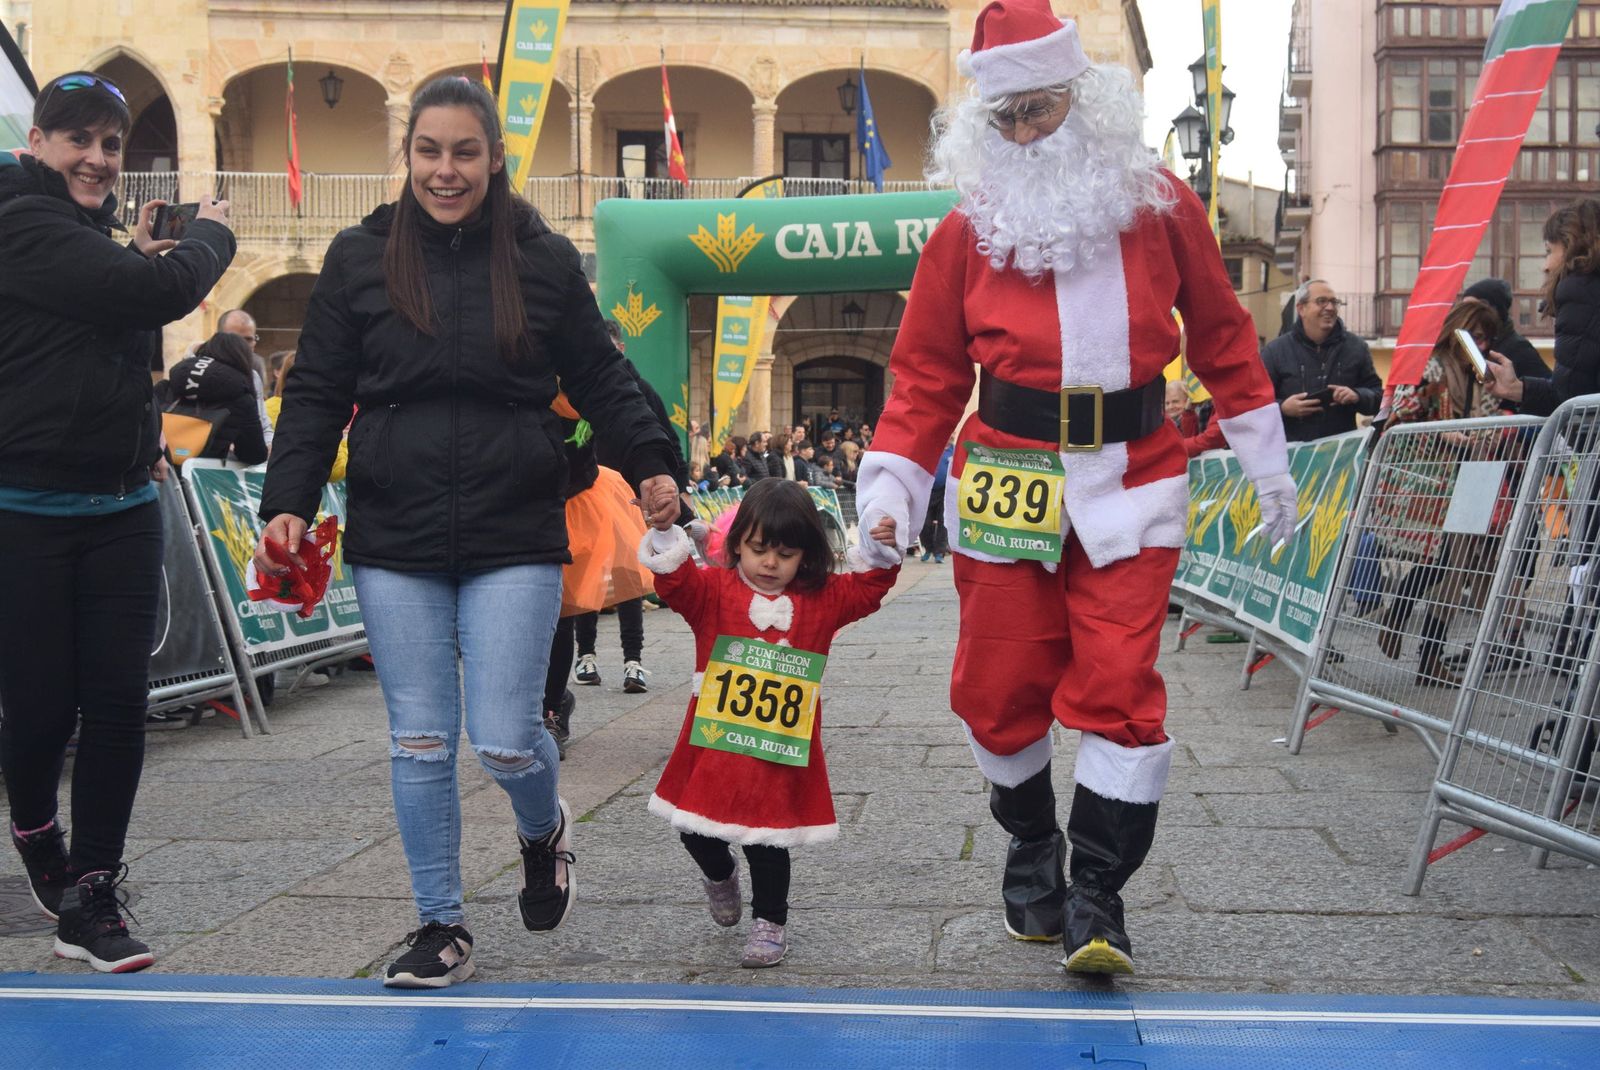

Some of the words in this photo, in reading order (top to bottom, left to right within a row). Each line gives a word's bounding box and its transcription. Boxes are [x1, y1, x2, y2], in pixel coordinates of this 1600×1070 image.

[775, 221, 882, 261] CAJA
[967, 471, 1050, 524] 339
[984, 532, 1007, 547] CAJA
[745, 656, 773, 669] CAJA
[775, 662, 809, 678] RURAL
[747, 645, 811, 668] FUNDACION
[716, 669, 804, 728] 1358
[726, 731, 757, 748] CAJA
[760, 739, 802, 758] RURAL
